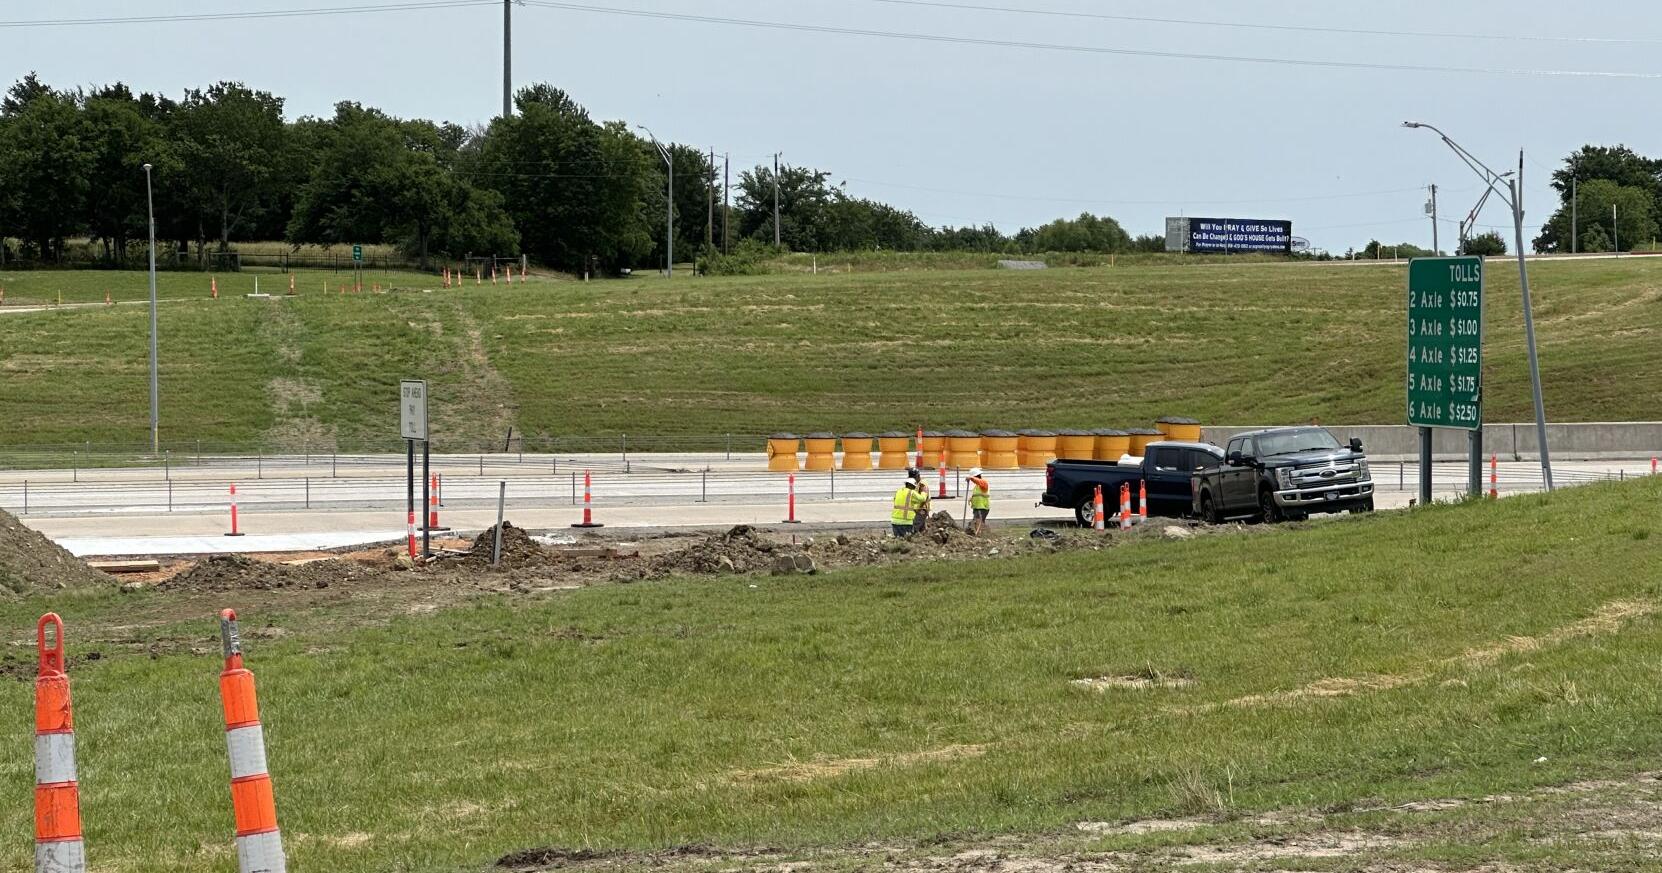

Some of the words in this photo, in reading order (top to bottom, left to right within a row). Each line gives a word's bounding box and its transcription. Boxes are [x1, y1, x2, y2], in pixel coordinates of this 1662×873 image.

[1212, 223, 1222, 231] You
[1450, 264, 1480, 282] TOLLS
[1410, 291, 1416, 308] 2
[1421, 291, 1442, 308] Axle
[1458, 291, 1478, 307] $0.75
[1410, 319, 1415, 336] 3
[1420, 319, 1442, 336] Axle
[1458, 318, 1478, 336] $1.00
[1410, 346, 1416, 363] 4
[1421, 346, 1443, 363] Axle
[1458, 346, 1478, 364] $1.25
[1409, 374, 1415, 390] 5
[1420, 374, 1442, 392] Axle
[1458, 375, 1475, 393] $1.75
[1409, 401, 1415, 418] 6
[1420, 401, 1441, 419] Axle
[1456, 404, 1476, 421] $2.50
